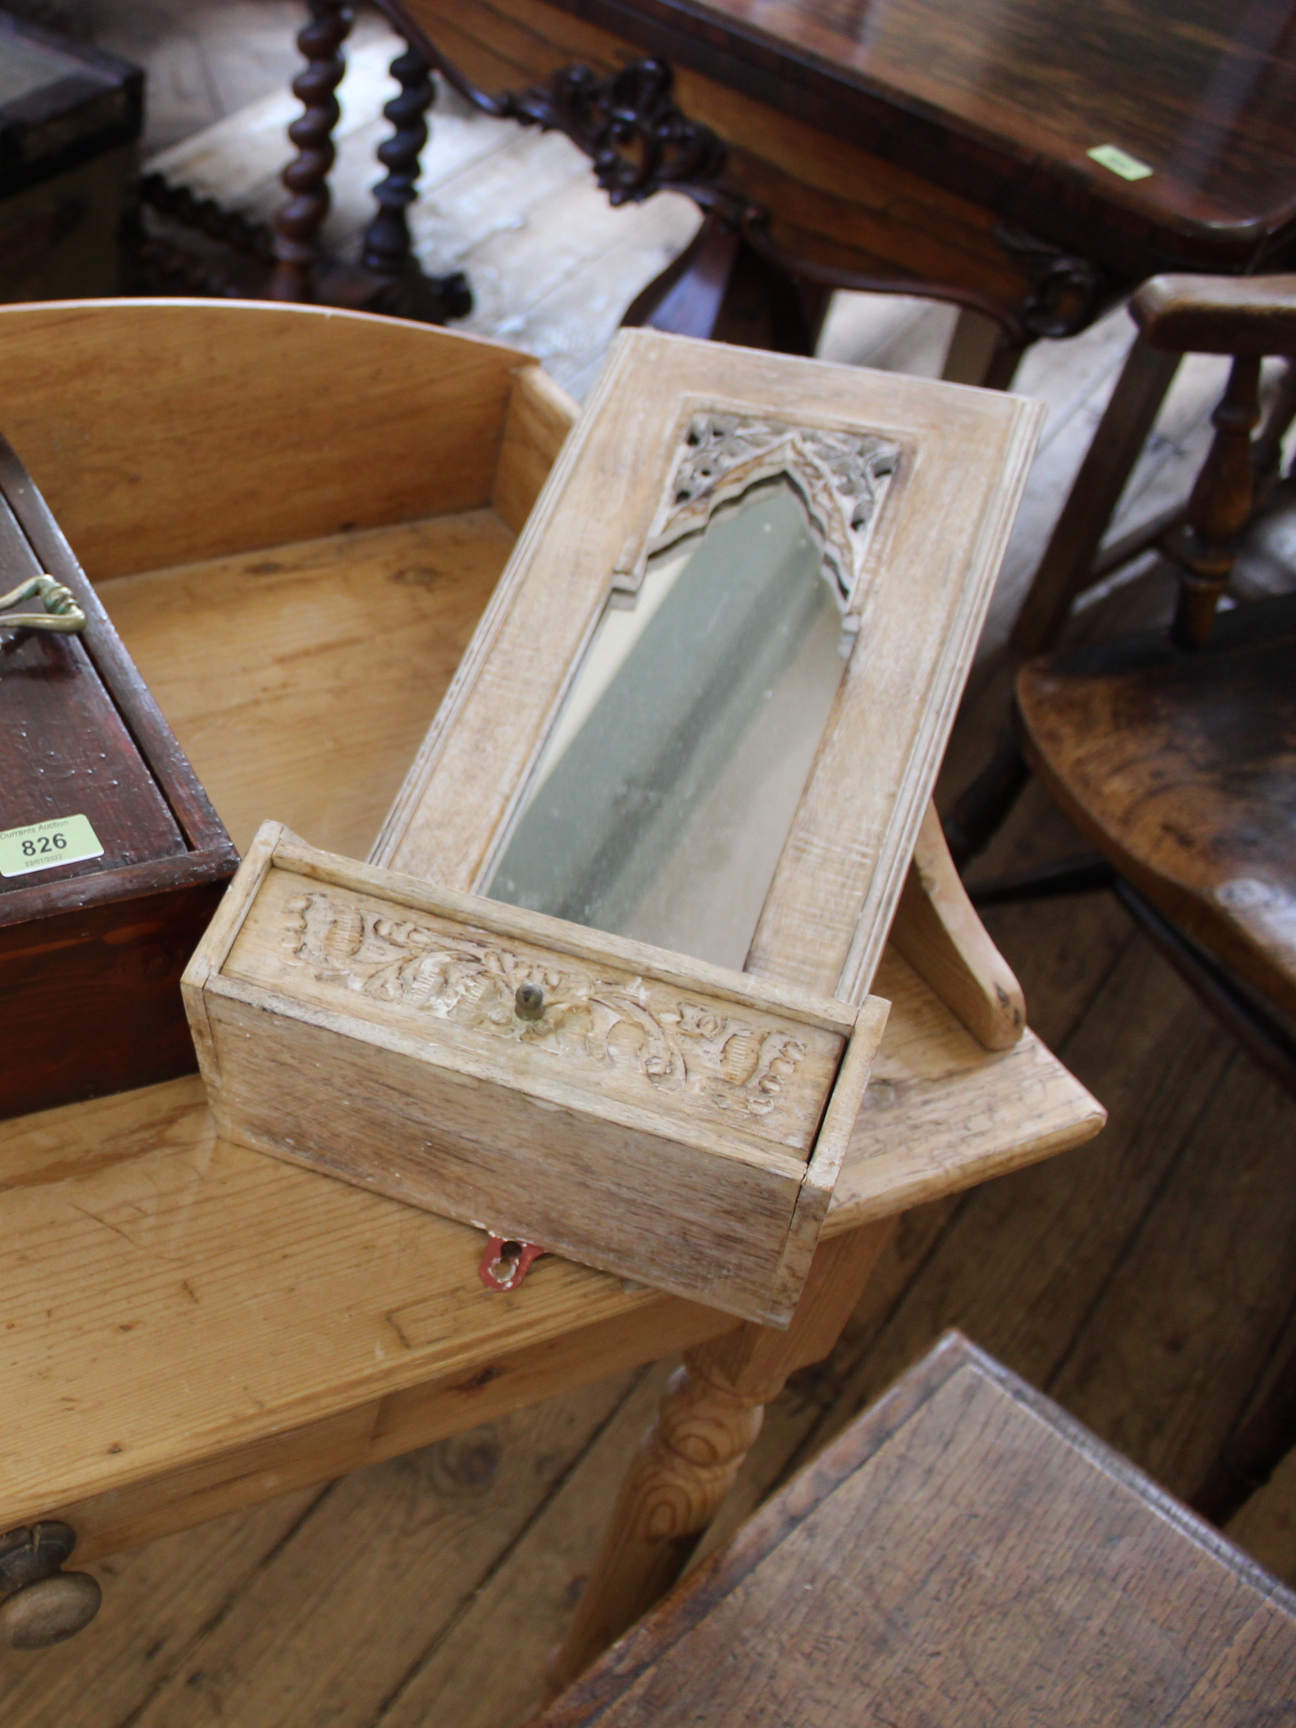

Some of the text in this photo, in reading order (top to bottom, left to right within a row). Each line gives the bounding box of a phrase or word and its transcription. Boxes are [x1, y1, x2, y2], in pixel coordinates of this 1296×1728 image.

[0, 820, 69, 841] Durrants Auction
[21, 833, 67, 856] 826
[25, 854, 63, 867] 22/07/2022
